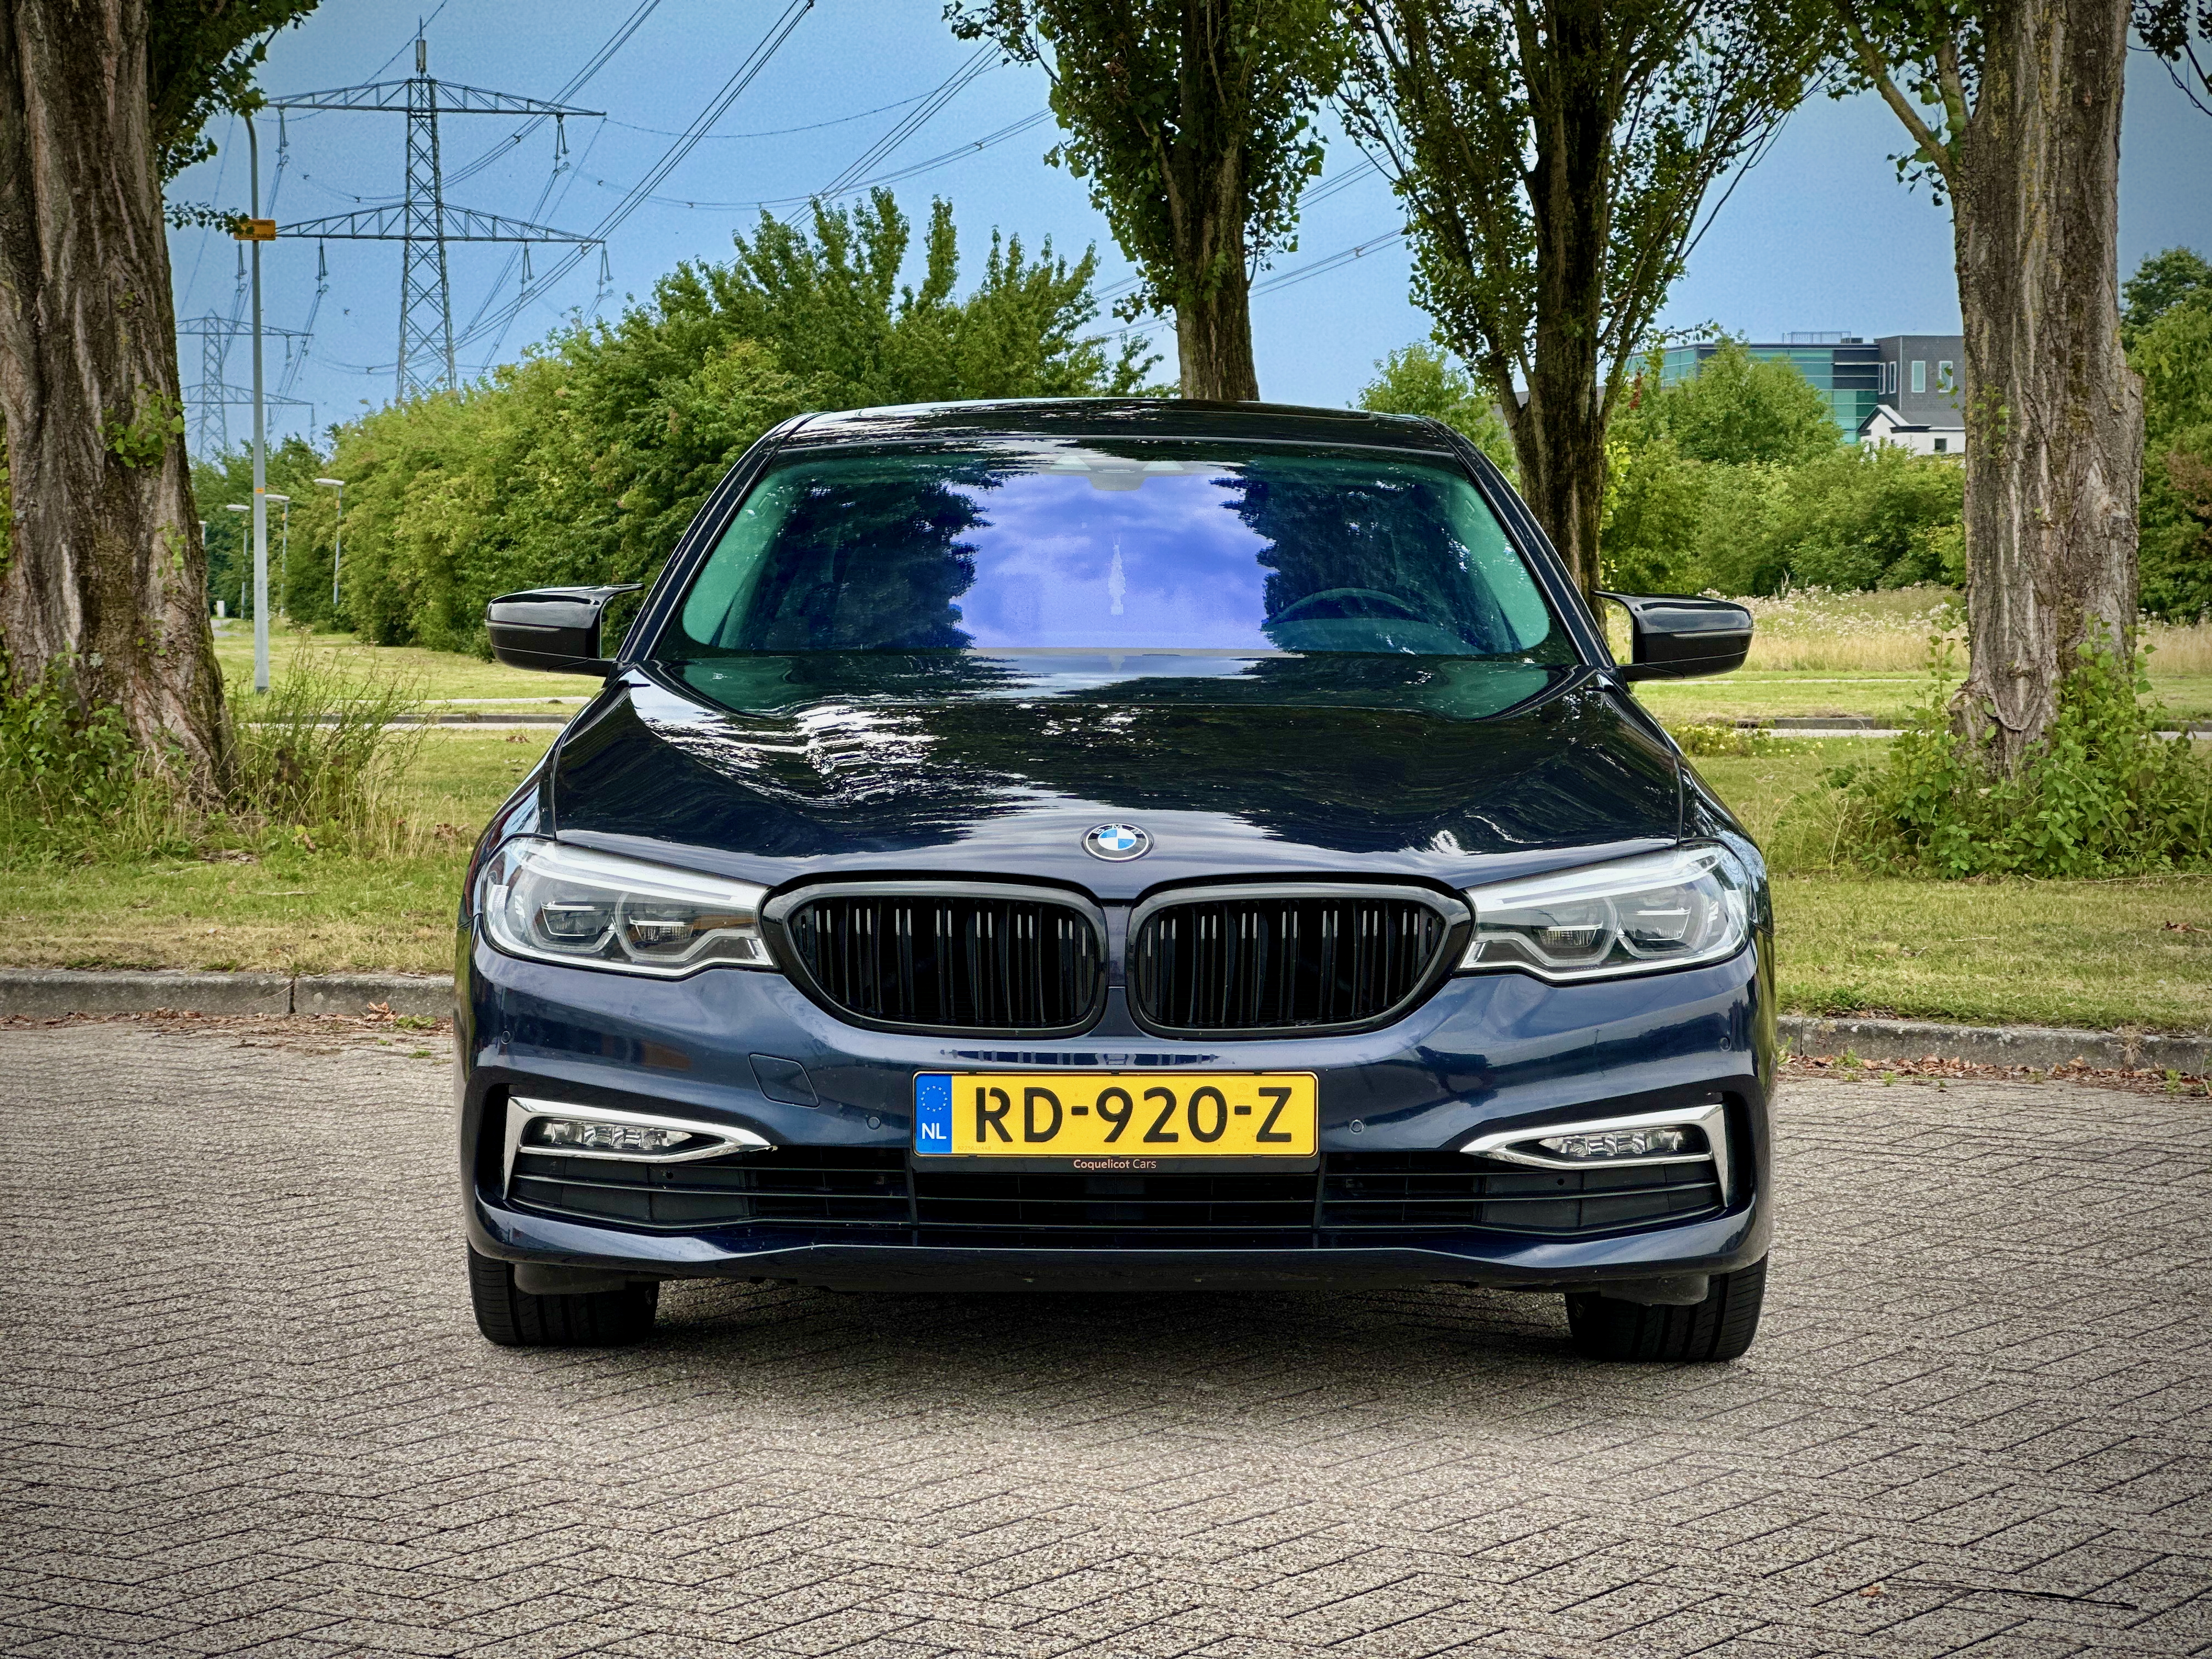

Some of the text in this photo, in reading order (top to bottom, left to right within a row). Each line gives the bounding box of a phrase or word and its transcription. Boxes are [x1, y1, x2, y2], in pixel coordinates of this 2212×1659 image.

[976, 1086, 1292, 1143] RD-920-Z
[922, 1122, 947, 1139] NL
[1073, 1159, 1156, 1170] Coquelicot Cars
